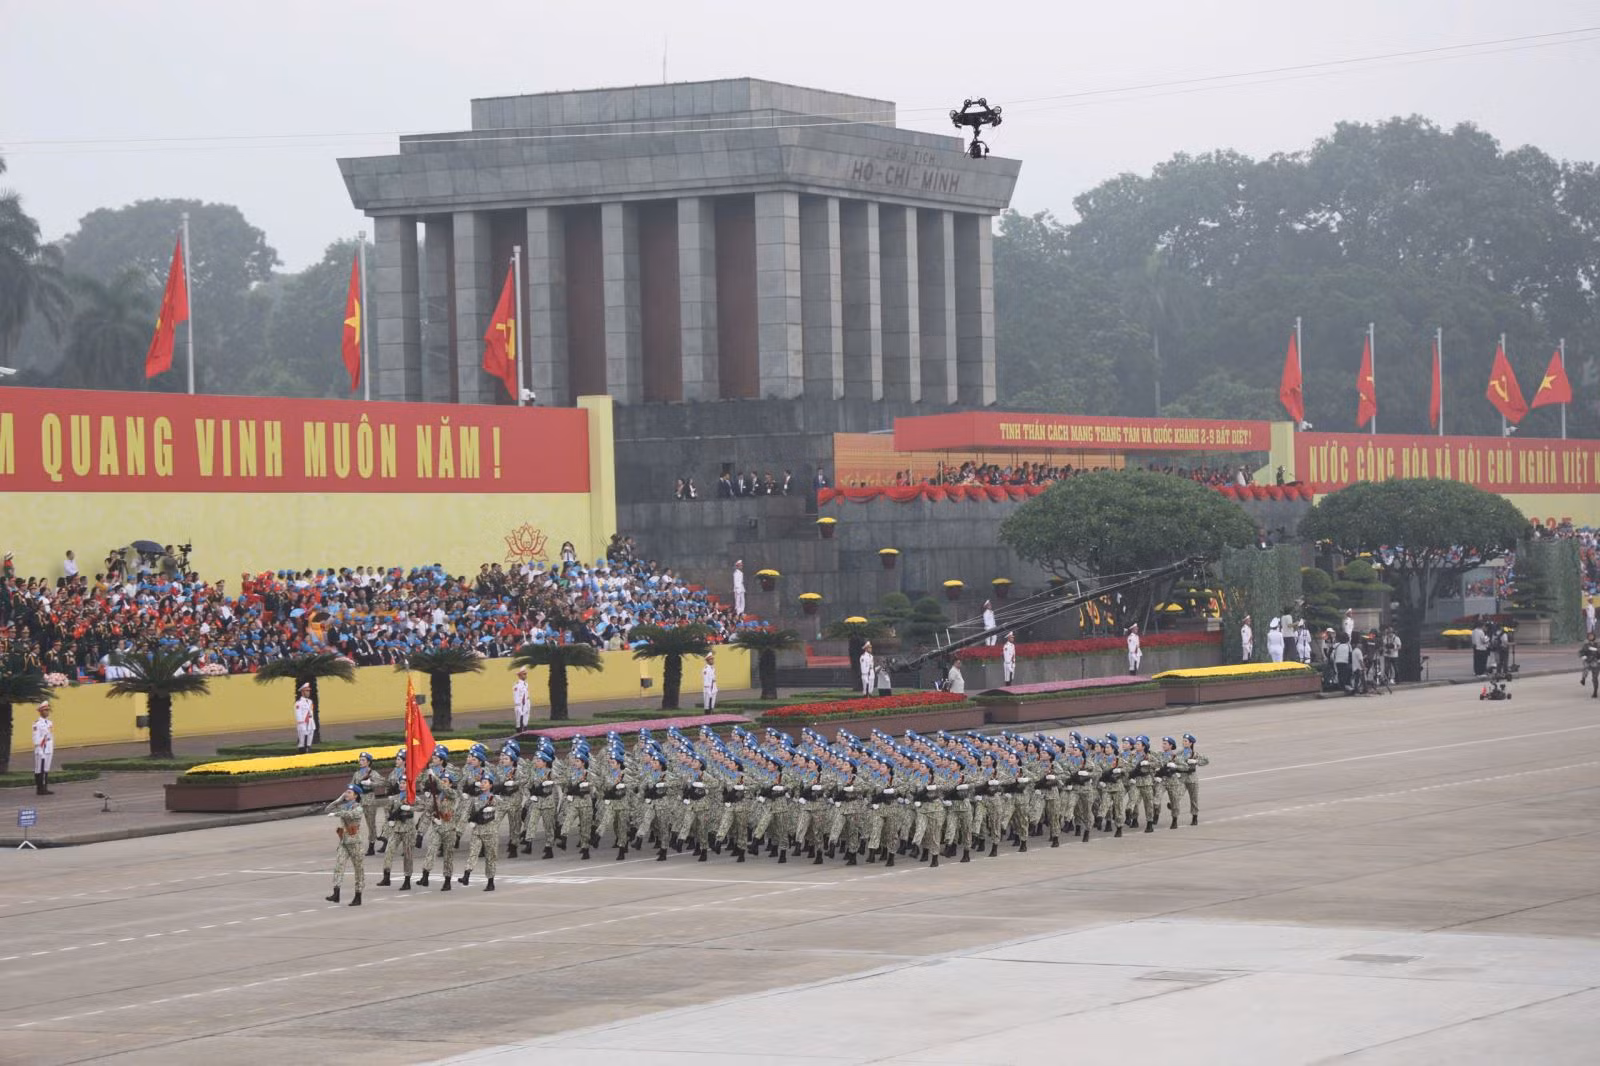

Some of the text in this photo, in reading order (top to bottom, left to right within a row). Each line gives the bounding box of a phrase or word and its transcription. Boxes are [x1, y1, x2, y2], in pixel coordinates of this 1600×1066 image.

[41, 412, 174, 482] QUANG
[195, 418, 282, 477] VINH
[304, 413, 397, 479] MUÔN
[416, 415, 480, 479] NĂM
